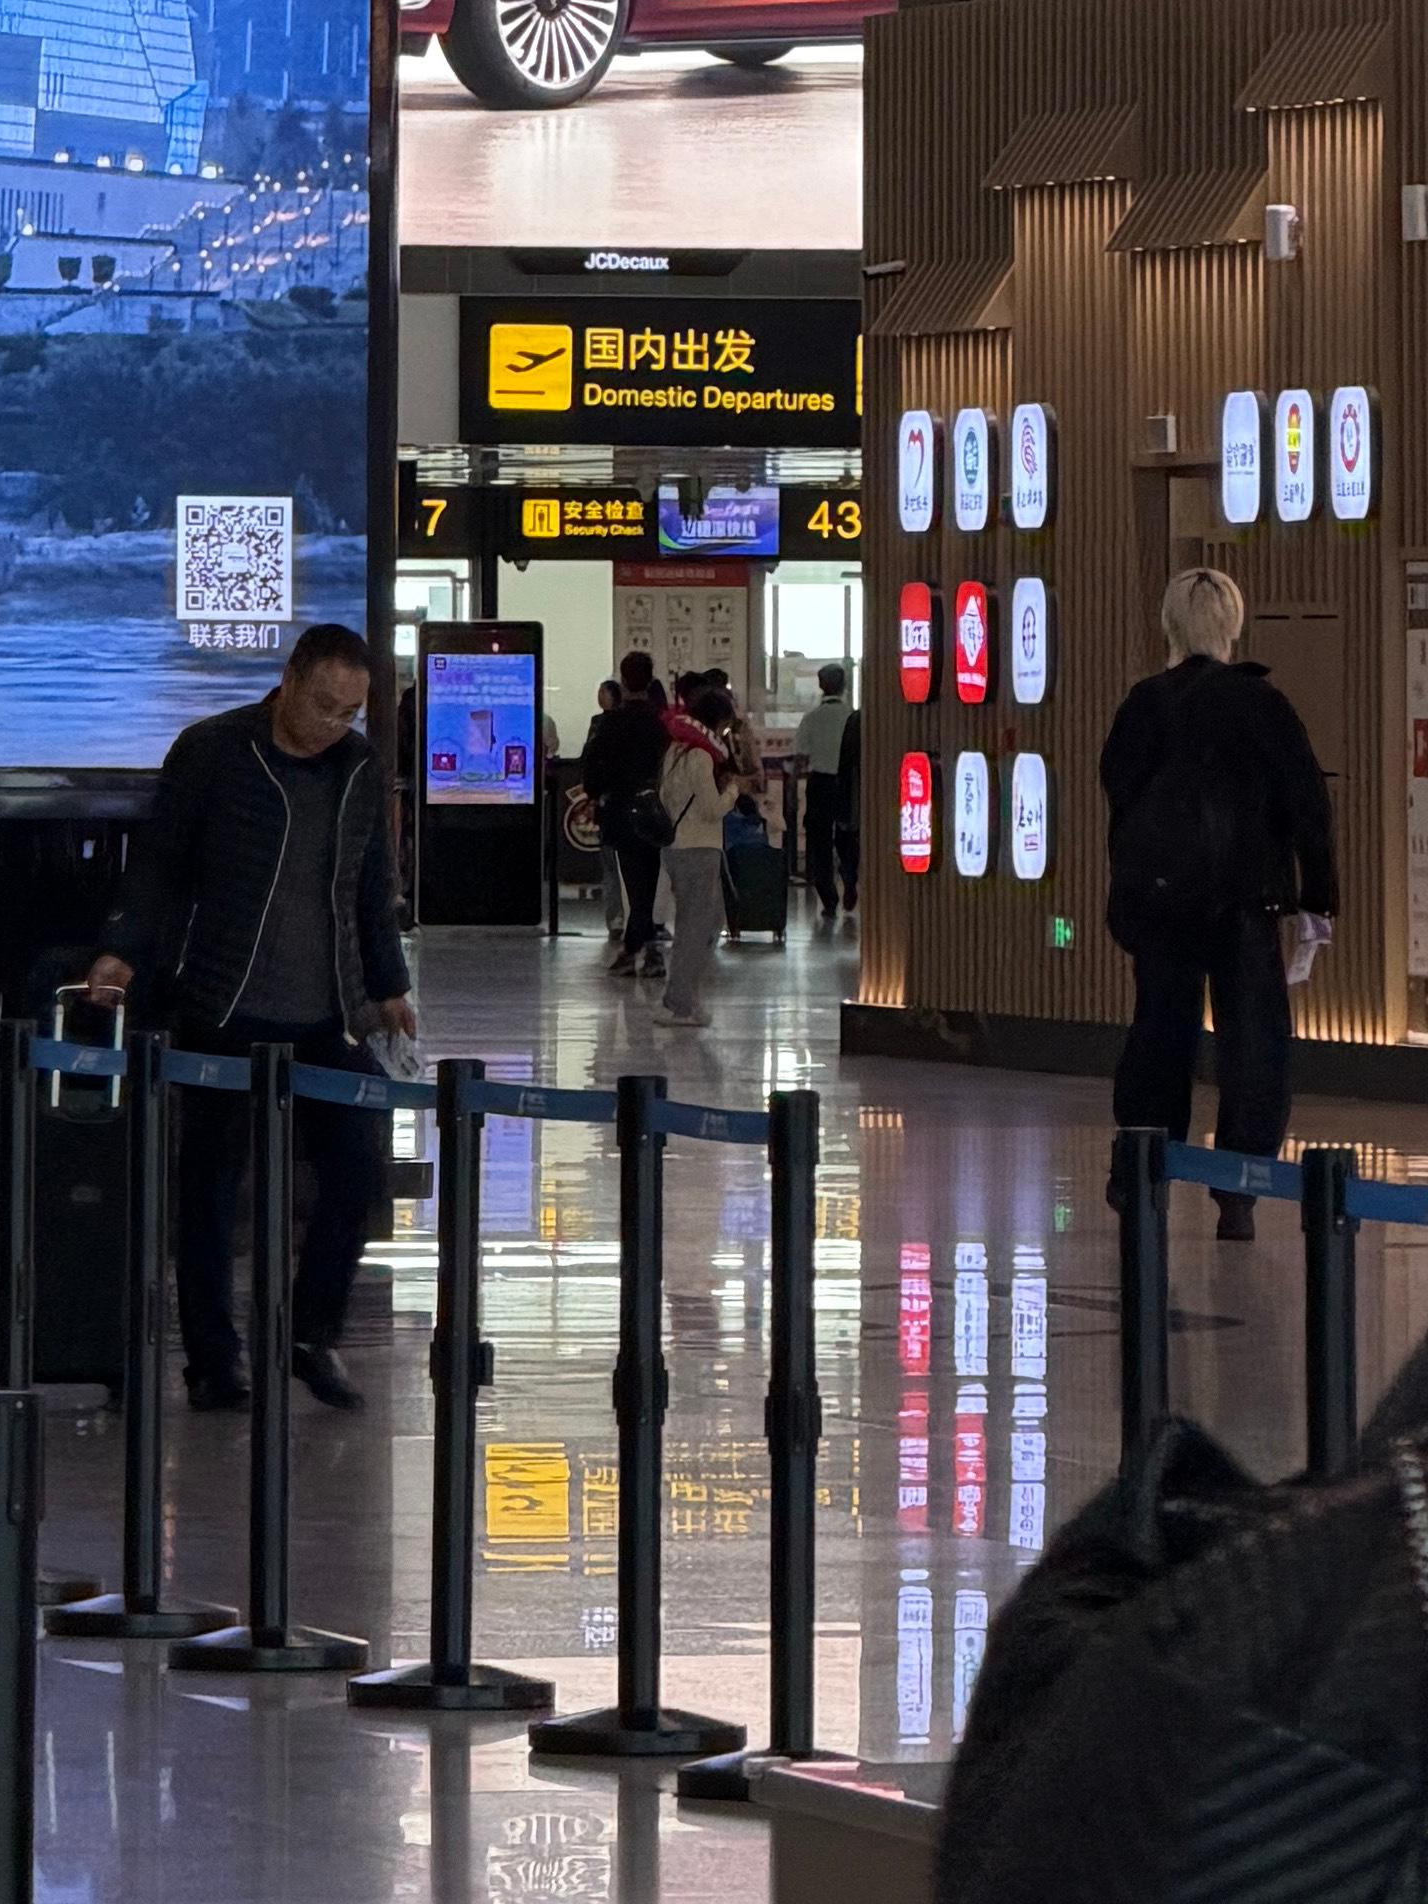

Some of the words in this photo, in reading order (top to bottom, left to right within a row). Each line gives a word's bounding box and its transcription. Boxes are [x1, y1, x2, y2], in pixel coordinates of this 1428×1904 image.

[584, 252, 670, 272] JCDecaux
[583, 326, 756, 375] 国内出发
[584, 383, 695, 410] Domestic
[703, 385, 836, 415] Departures
[563, 500, 645, 521] 安全检查
[806, 500, 863, 540] 43
[187, 622, 281, 650] 联系我们
